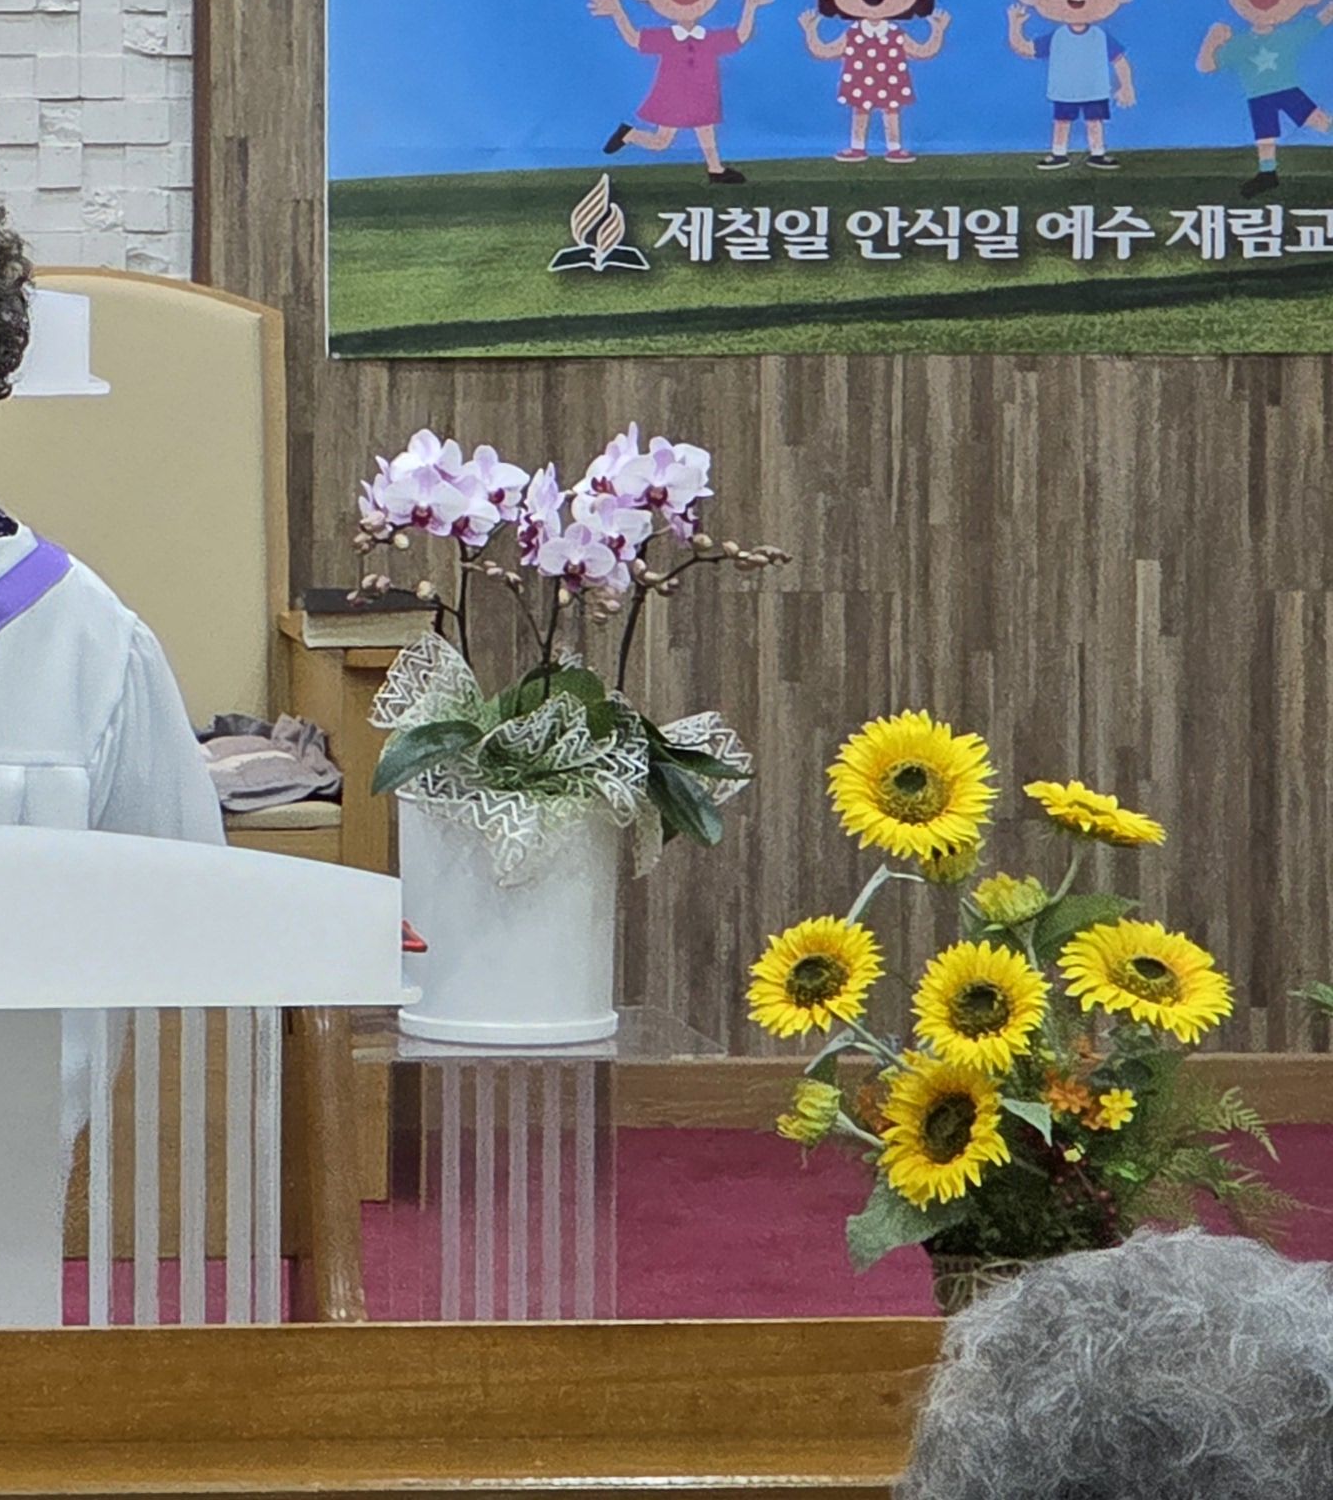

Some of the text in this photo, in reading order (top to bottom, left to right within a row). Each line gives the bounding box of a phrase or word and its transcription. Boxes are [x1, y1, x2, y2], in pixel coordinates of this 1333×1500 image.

[653, 204, 1333, 262] 제칠일 안식일 예수 재림교
